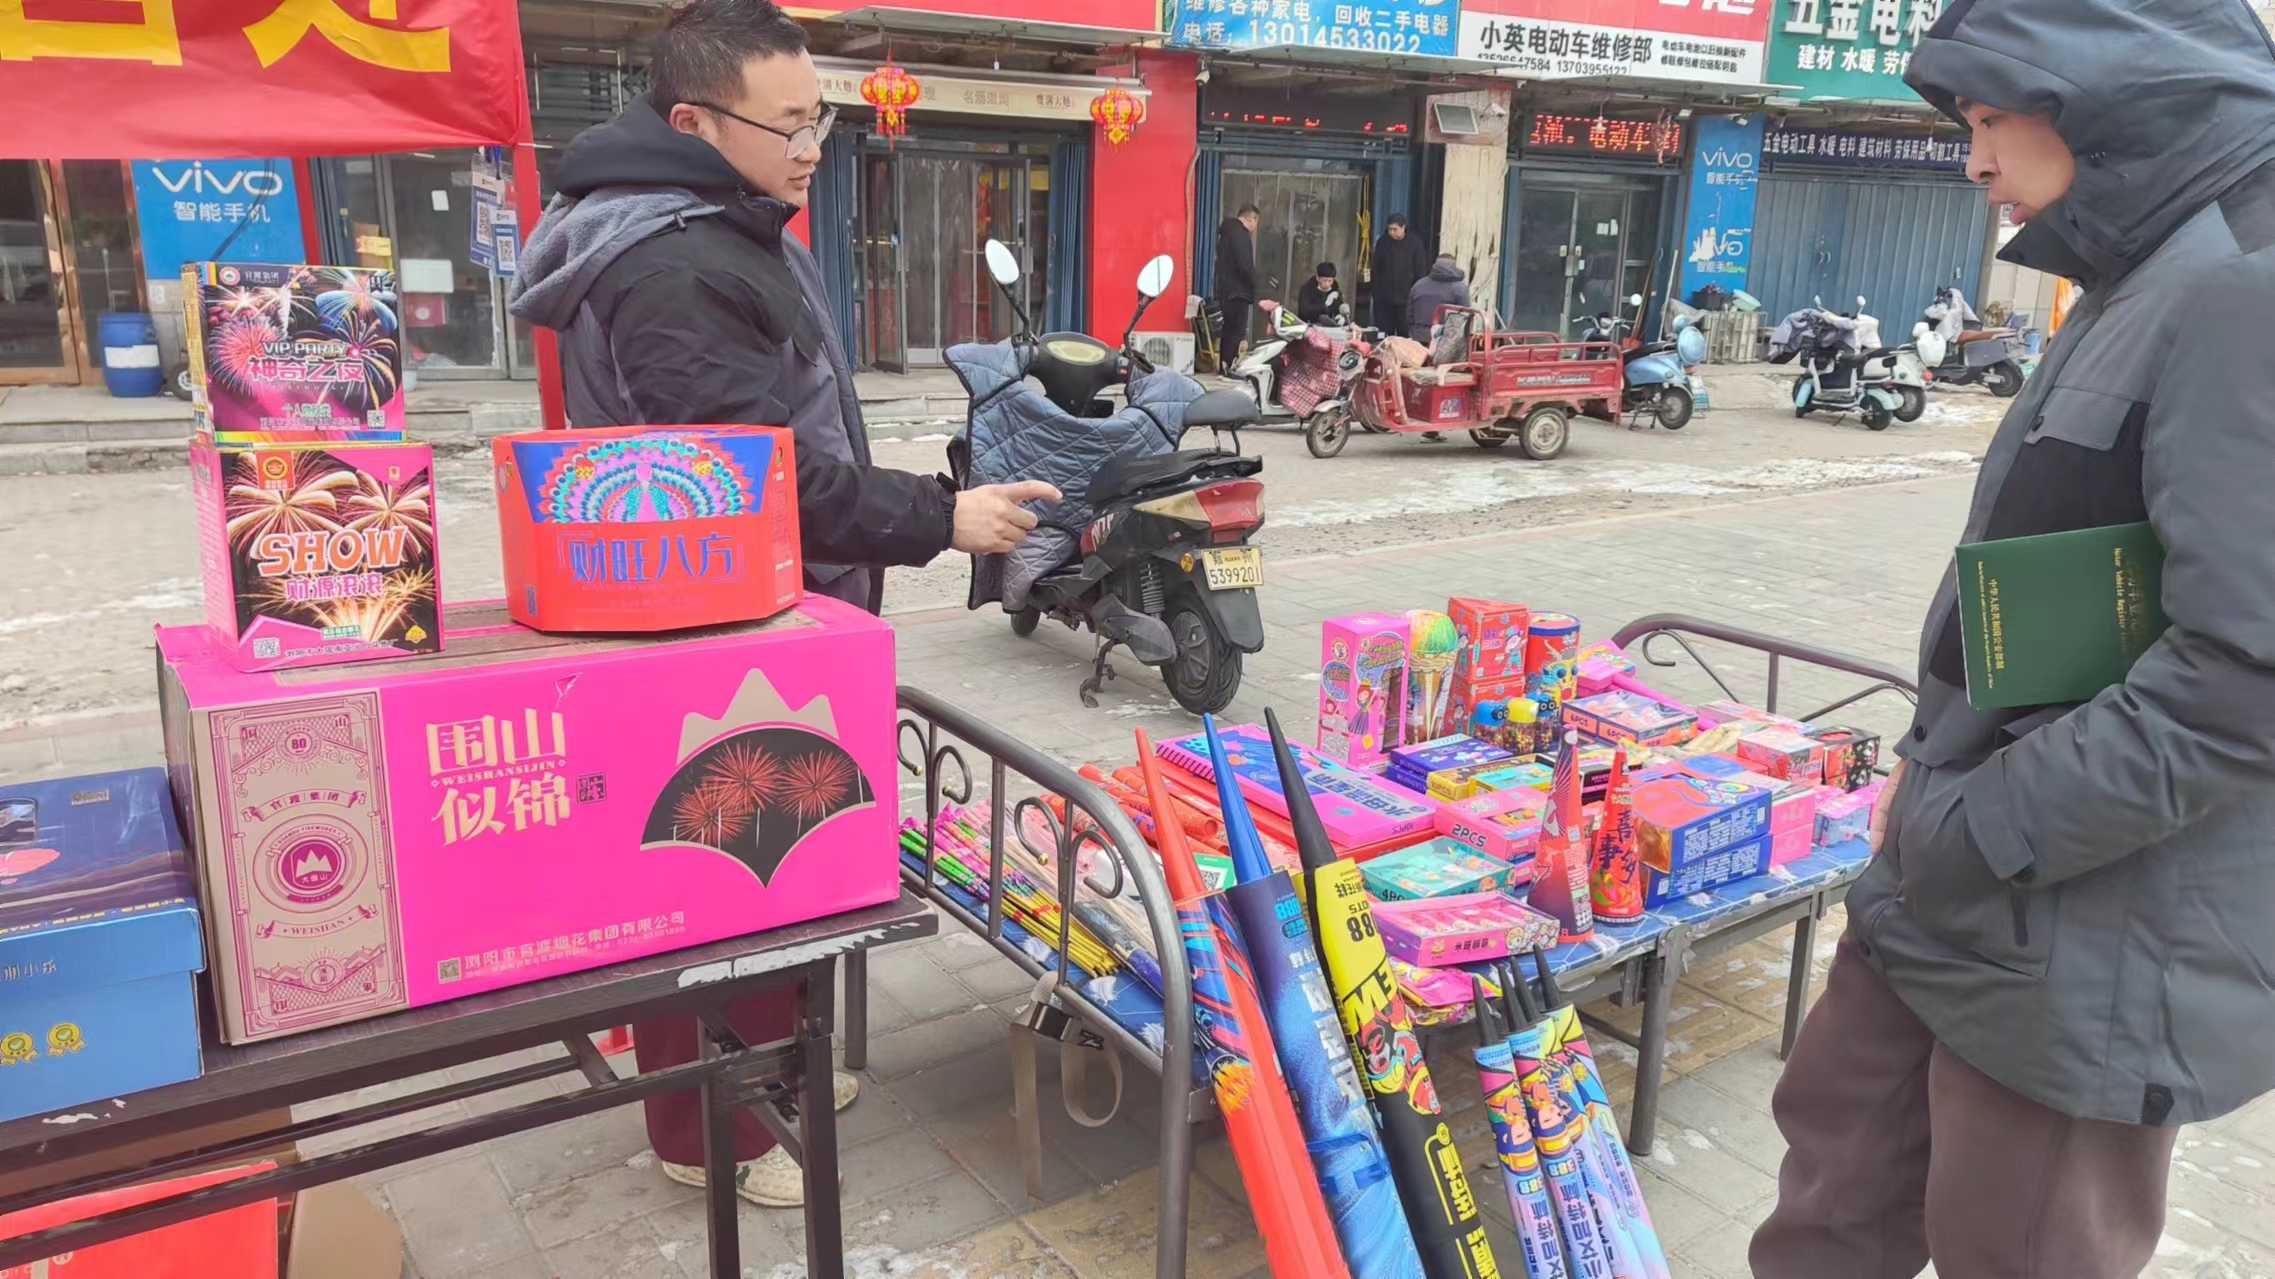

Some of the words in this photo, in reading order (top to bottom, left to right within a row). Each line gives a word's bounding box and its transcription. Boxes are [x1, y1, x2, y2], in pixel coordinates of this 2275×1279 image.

[1480, 21, 1653, 64] 小英电动车维修部
[1797, 44, 1836, 70] 建材
[1841, 46, 1877, 74] 水暖
[1702, 147, 1753, 168] vivo
[152, 162, 283, 196] vivo
[173, 200, 271, 223] 智能手机
[263, 341, 293, 354] VIP
[294, 342, 348, 355] PARTY
[248, 356, 365, 383] 神奇之夜
[259, 526, 407, 577] SHOW
[568, 532, 734, 583] 财旺八方
[285, 572, 384, 602] 财源滚滚
[426, 708, 566, 777] 围山
[441, 760, 556, 787] WEISHANSIJIN
[431, 772, 571, 847] 似锦
[1451, 823, 1488, 848] 2PCS
[291, 919, 345, 937] WEISHAN
